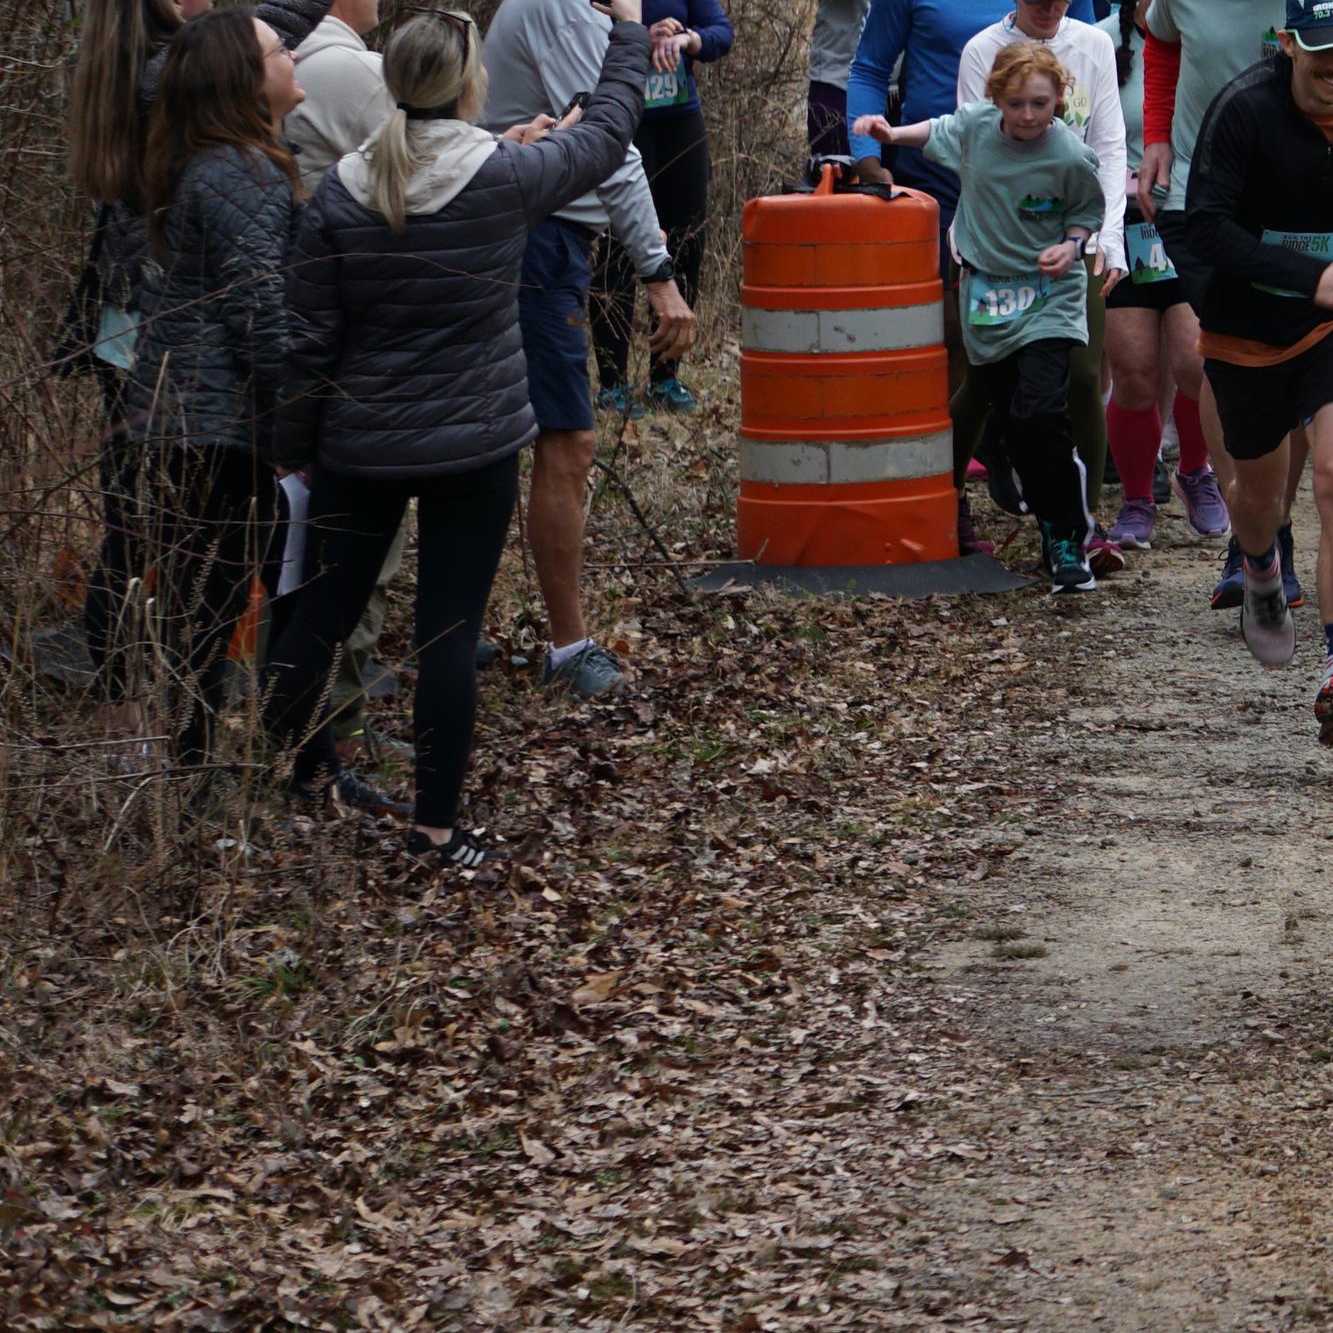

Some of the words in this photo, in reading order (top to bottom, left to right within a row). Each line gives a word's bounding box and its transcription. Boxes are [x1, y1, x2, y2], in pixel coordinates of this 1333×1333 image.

[1315, 10, 1331, 19] 70.3
[1073, 96, 1087, 107] GO
[1311, 236, 1331, 252] 5K
[985, 287, 1036, 317] 130
